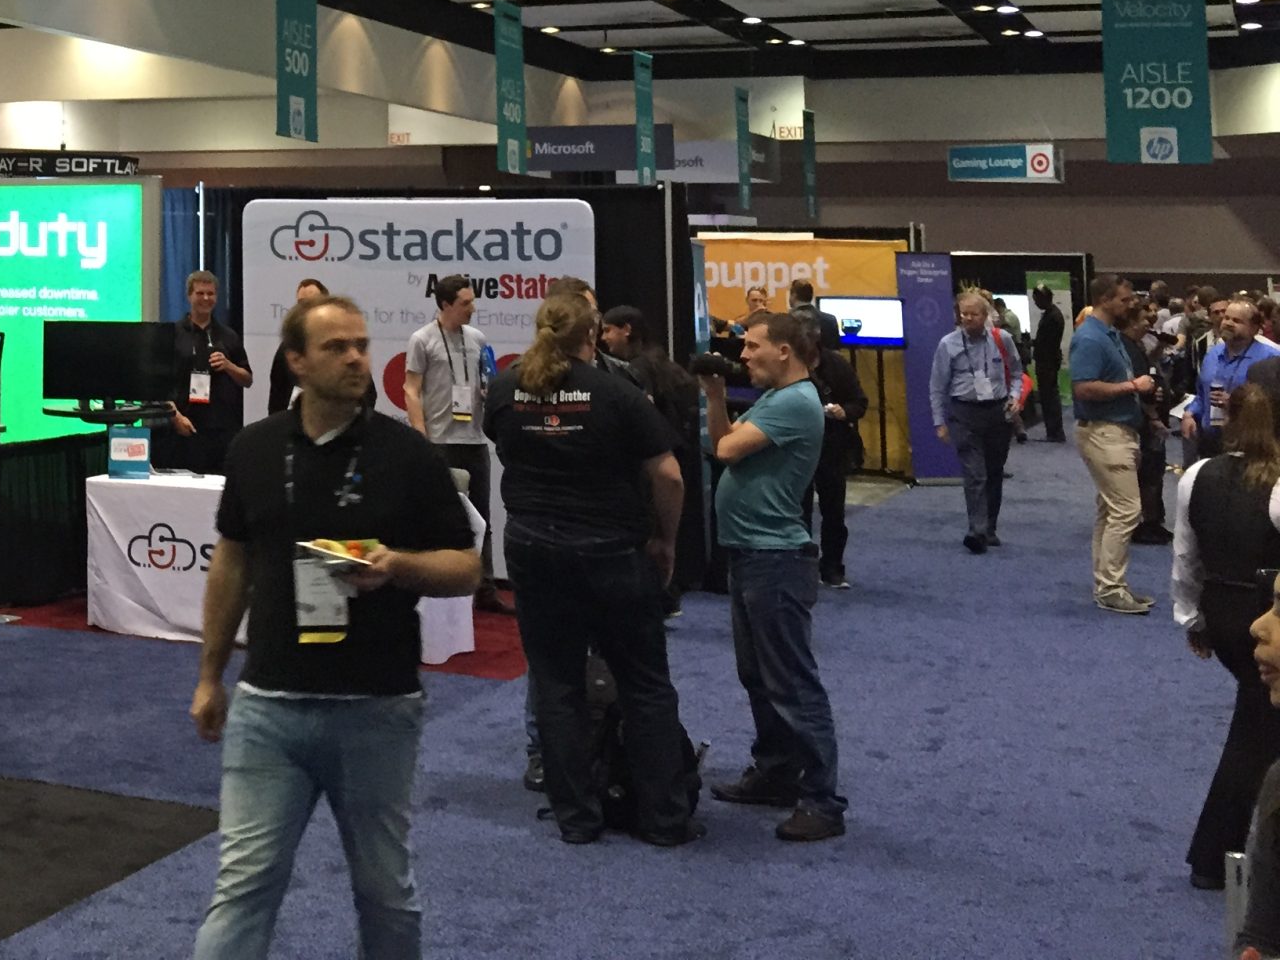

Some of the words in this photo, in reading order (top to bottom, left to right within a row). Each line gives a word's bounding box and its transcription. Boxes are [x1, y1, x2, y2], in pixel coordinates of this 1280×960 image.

[1113, 0, 1193, 20] Velocity
[285, 48, 309, 77] 500
[1120, 62, 1193, 85] AISLE
[1122, 88, 1193, 109] 1200
[389, 132, 411, 144] EXIT
[779, 126, 804, 139] EXIT
[534, 141, 595, 155] Microsoft
[1146, 136, 1173, 160] hp
[55, 157, 138, 176] SOFTLAY
[674, 155, 704, 168] osoft
[952, 157, 988, 170] Gaming
[988, 157, 1024, 170] Lounge
[357, 218, 563, 262] stackato
[407, 271, 425, 288] by
[374, 308, 397, 324] for
[400, 309, 426, 326] the
[477, 309, 534, 330] Enterp
[559, 389, 592, 402] Brother
